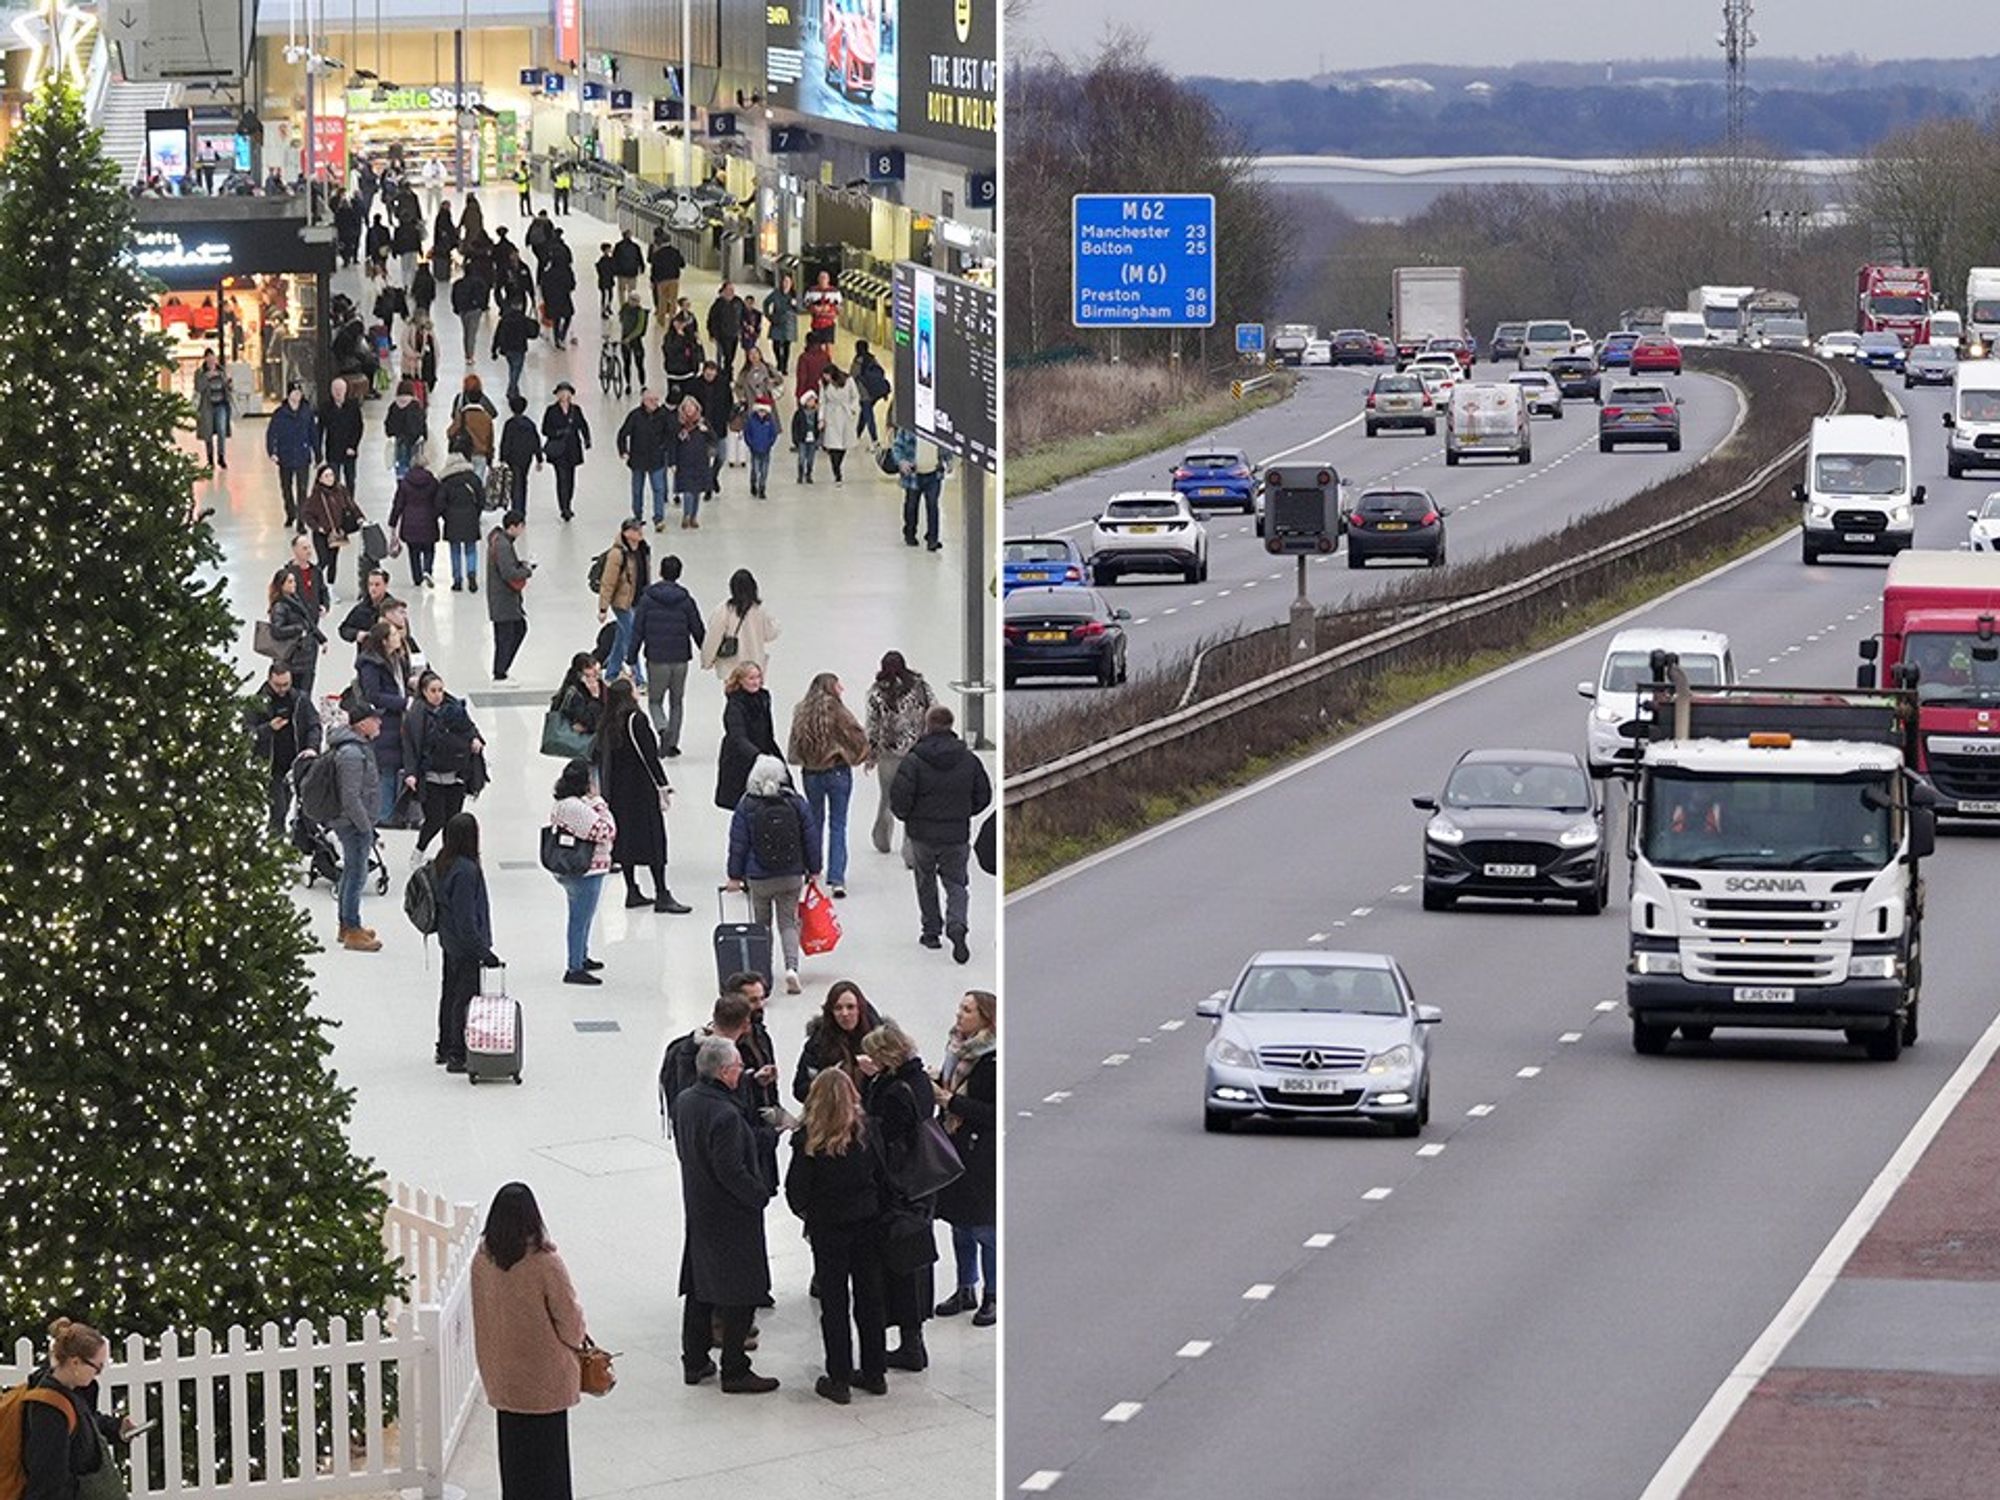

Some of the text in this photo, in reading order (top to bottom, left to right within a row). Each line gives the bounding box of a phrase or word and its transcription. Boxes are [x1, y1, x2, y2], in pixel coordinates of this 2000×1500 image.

[930, 55, 949, 87] THE
[952, 57, 978, 90] BEST
[549, 77, 558, 89] 2
[615, 94, 624, 105] 4
[660, 104, 669, 116] 5
[715, 119, 726, 132] 6
[778, 133, 788, 147] 7
[879, 157, 891, 174] 8
[981, 181, 995, 200] 9
[1081, 225, 1206, 239] Manchester 23
[1081, 241, 1206, 255] Bolton 25
[1081, 288, 1206, 302] Preston 36
[1081, 304, 1206, 320] Birmingham 88
[1725, 877, 1806, 893] SCANIA
